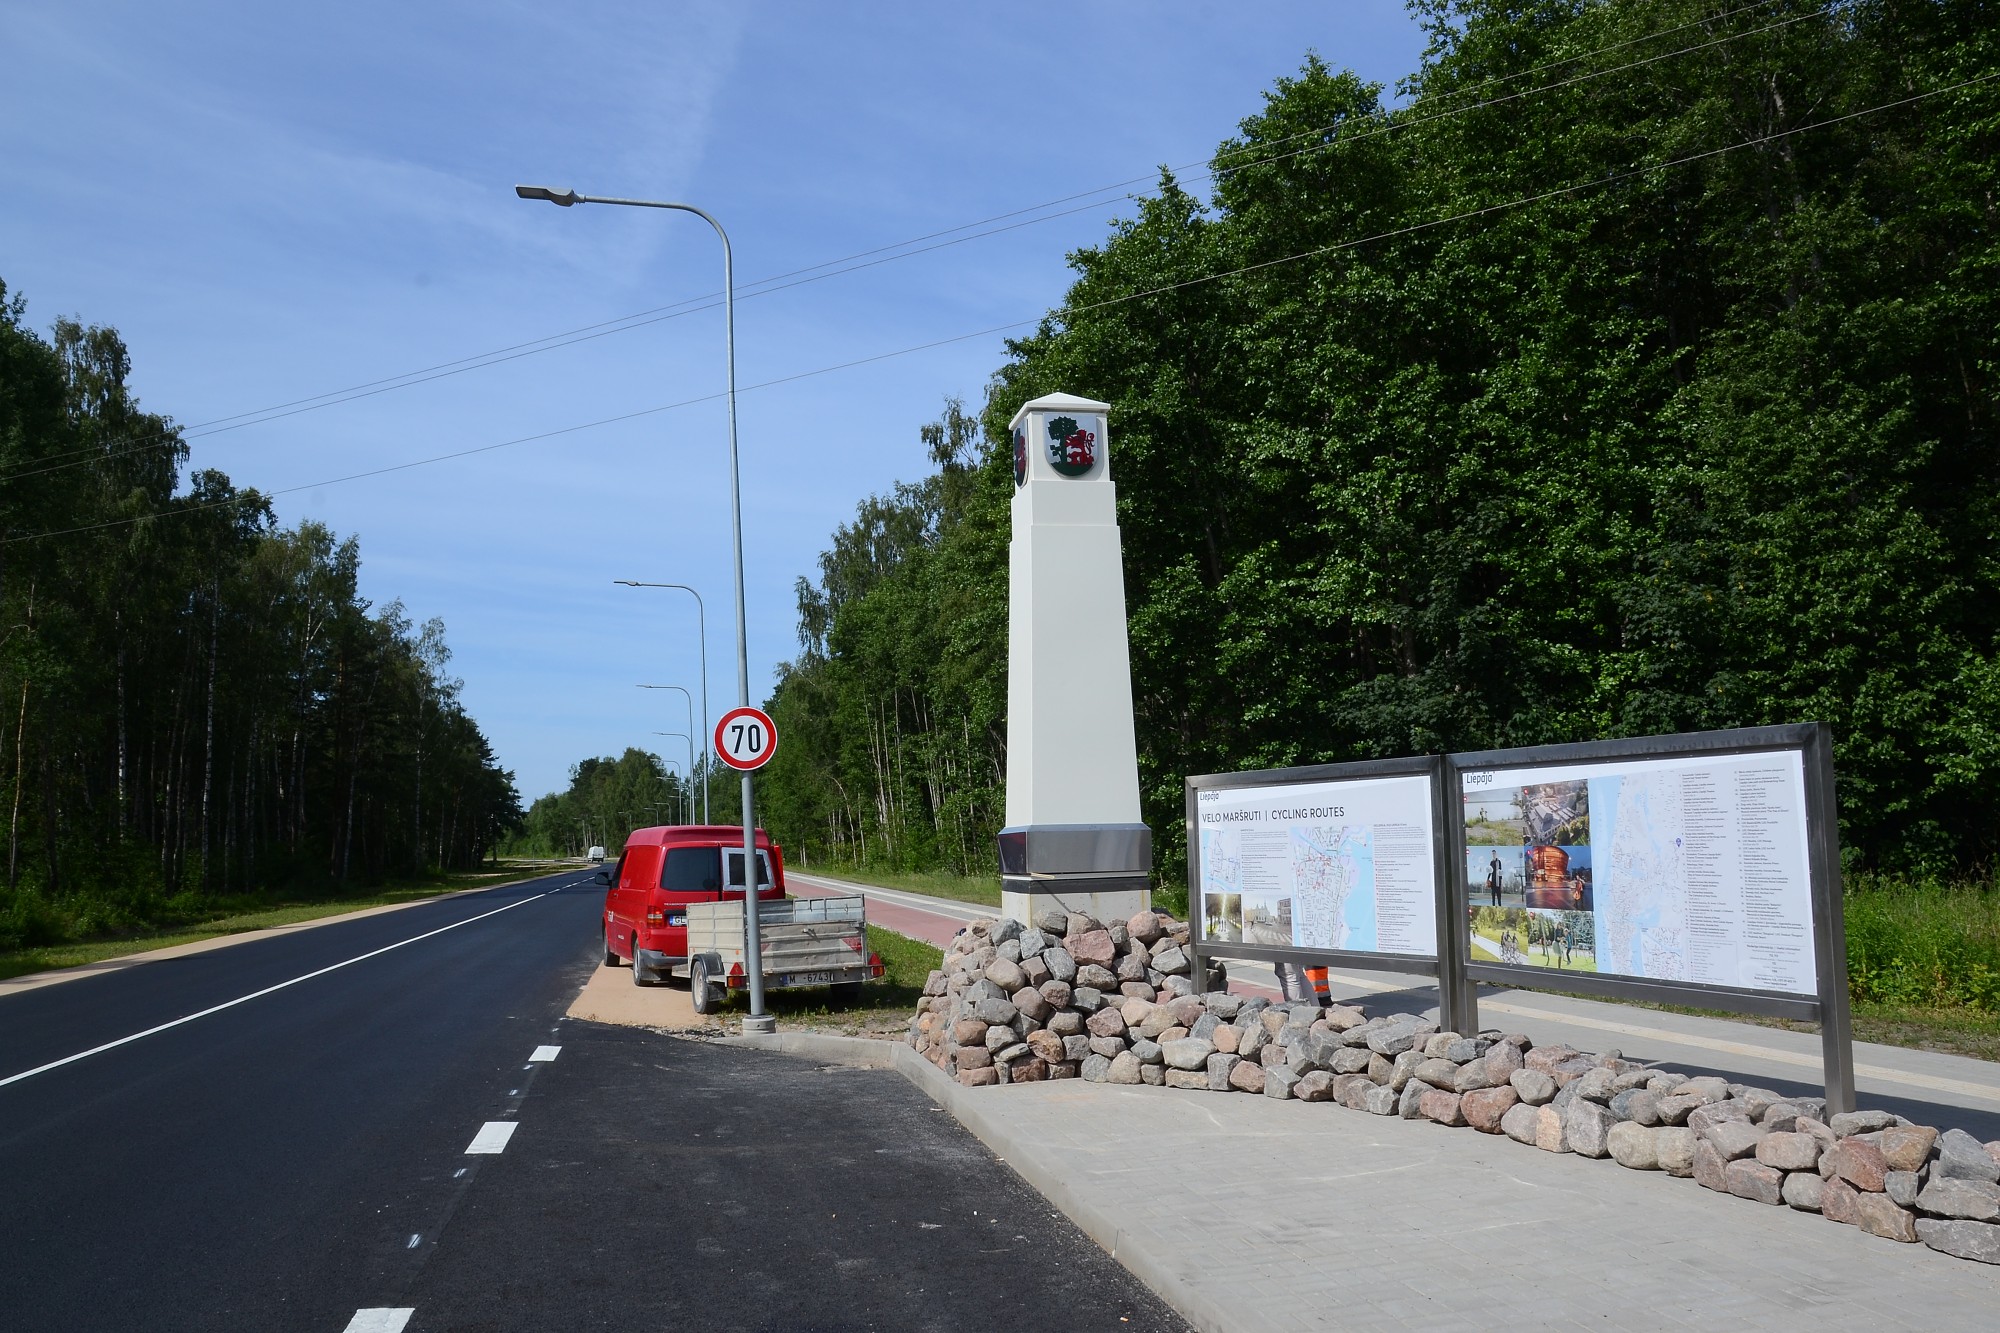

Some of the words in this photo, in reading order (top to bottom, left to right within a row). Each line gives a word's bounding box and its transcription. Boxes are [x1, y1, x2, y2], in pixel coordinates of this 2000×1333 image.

[732, 724, 761, 754] 70
[1202, 813, 1221, 823] VELO
[1222, 809, 1261, 822] MARŠRUTI
[1271, 808, 1308, 820] CYCLING
[1310, 806, 1345, 818] ROUTES
